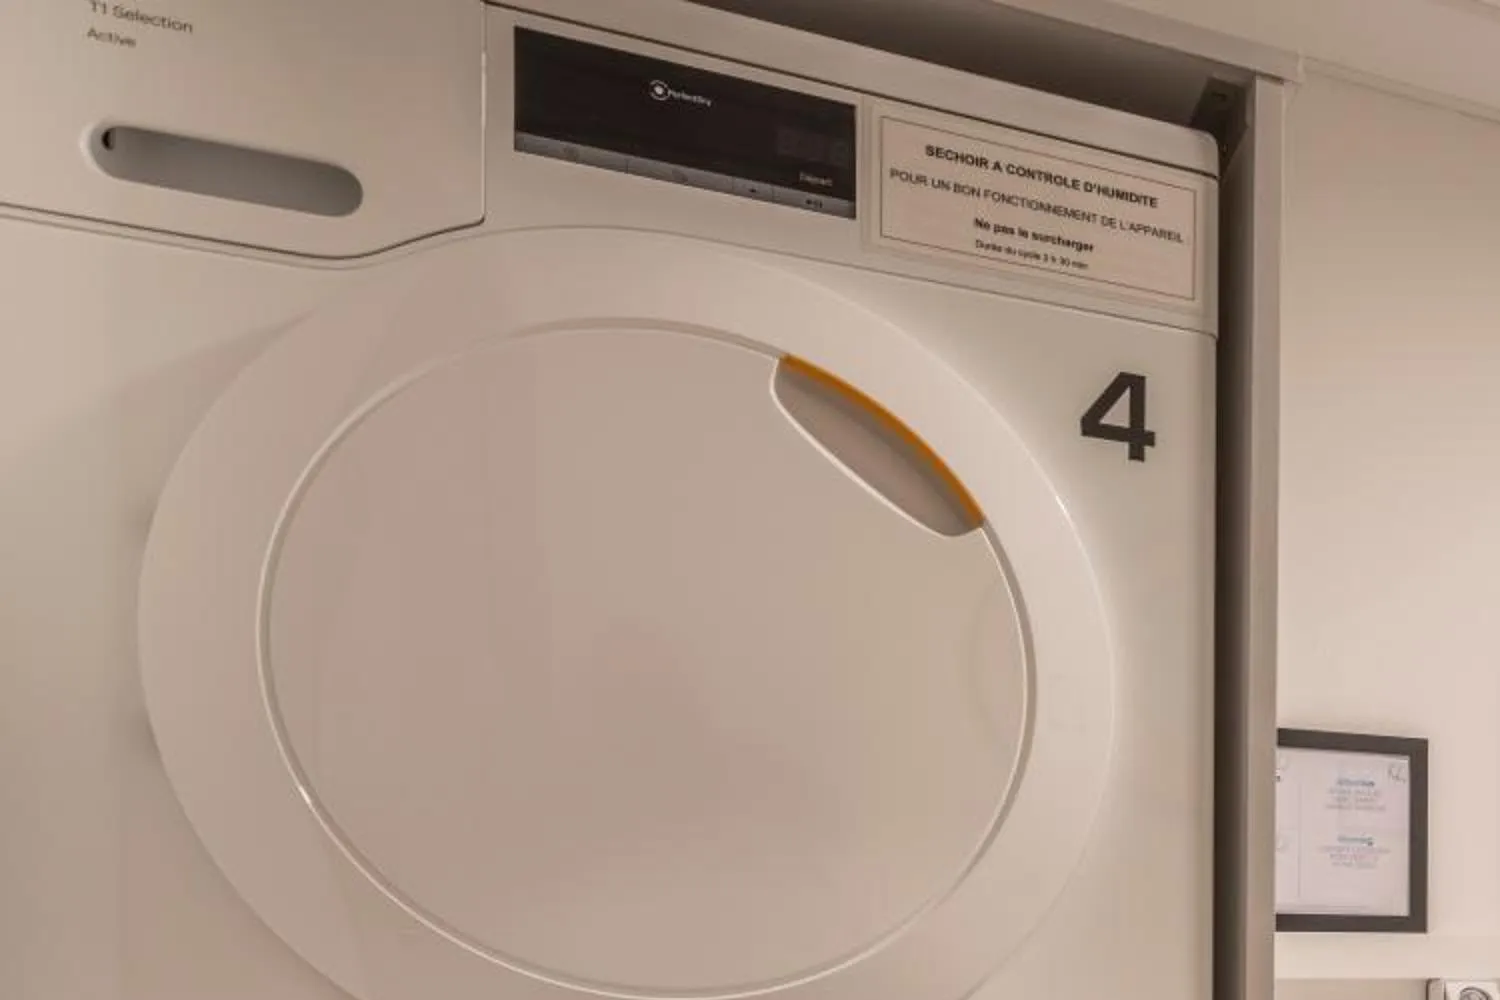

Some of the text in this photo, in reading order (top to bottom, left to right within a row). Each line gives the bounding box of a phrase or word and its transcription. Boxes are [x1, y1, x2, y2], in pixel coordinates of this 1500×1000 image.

[87, 27, 137, 48] Active
[112, 5, 194, 33] Selection
[925, 144, 1158, 209] SECHOIR A CONTROLE D'HUMIDITE
[890, 167, 1183, 244] POUR UN BON FONCTIONNEMENT DE L'APPAREIL
[973, 217, 991, 231] Ne
[993, 223, 1015, 238] pas
[1031, 229, 1094, 253] surcharger
[1080, 371, 1155, 463] 4
